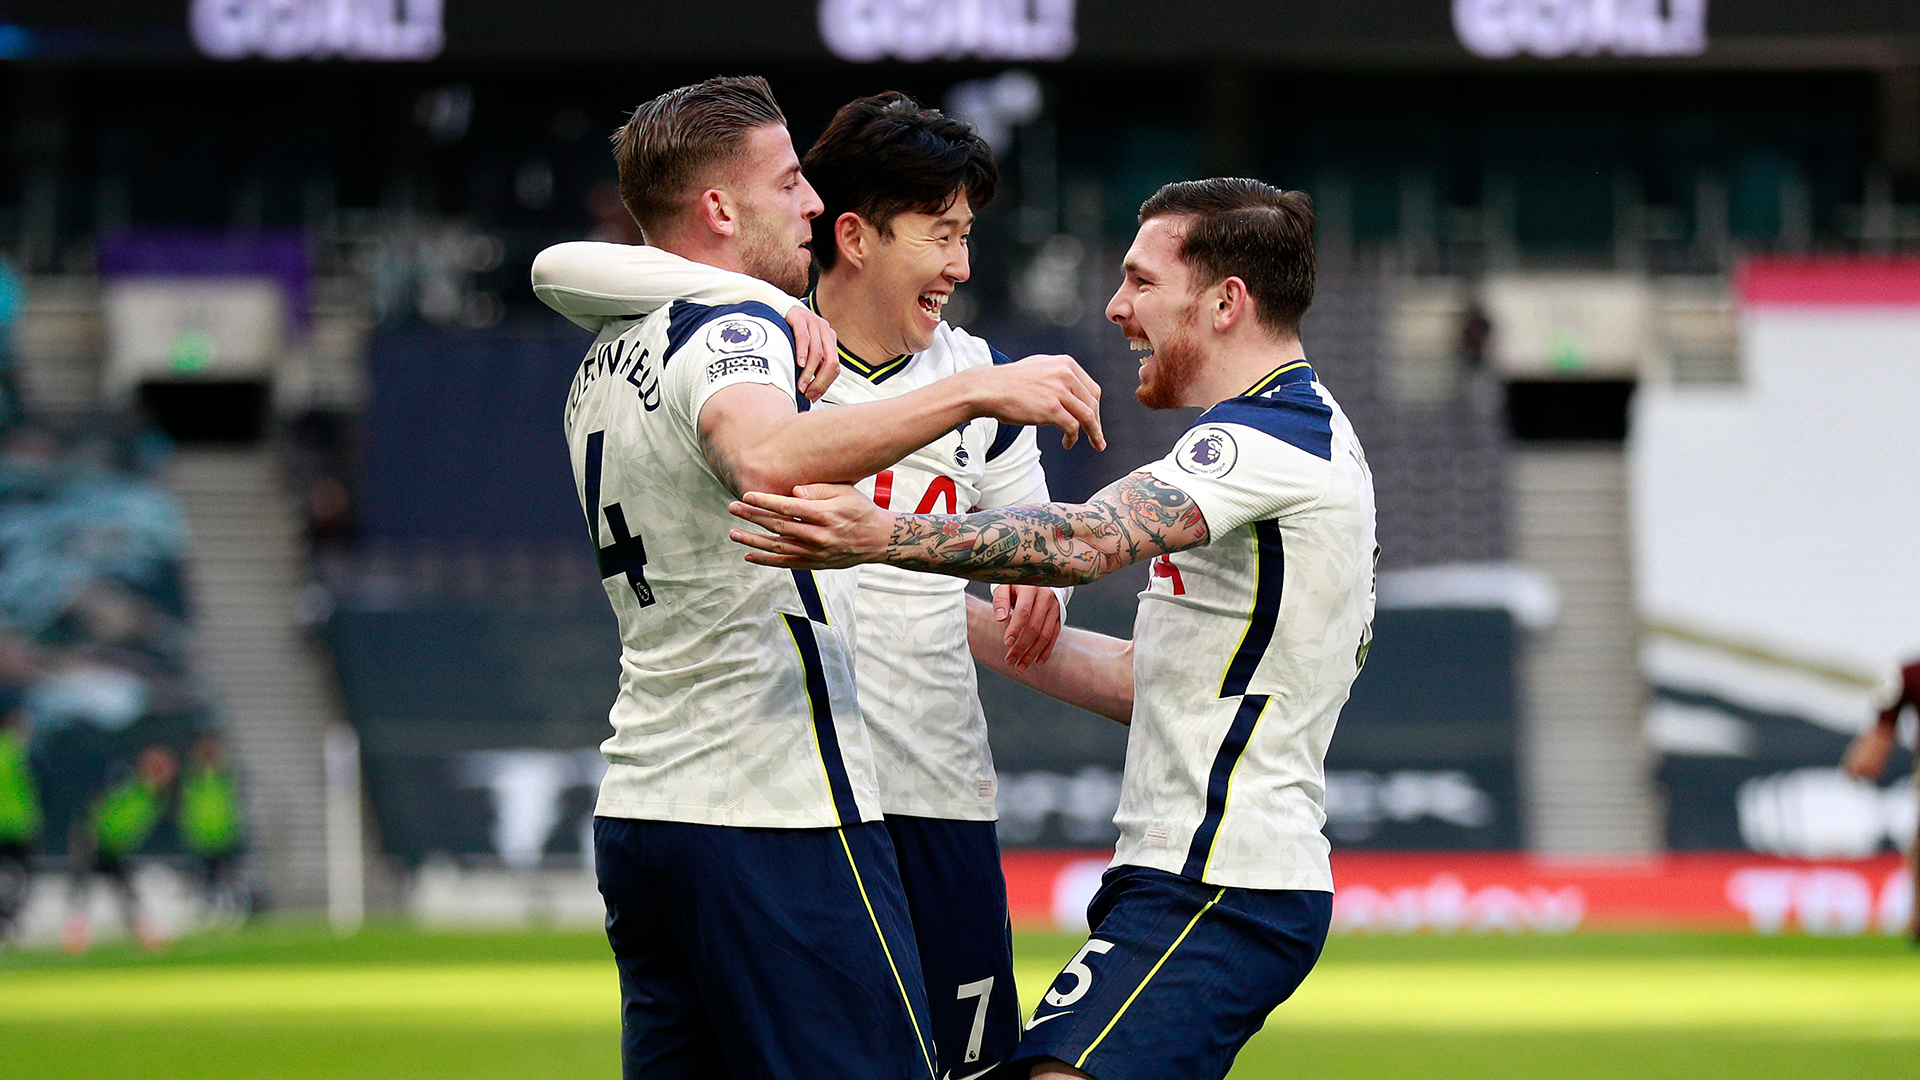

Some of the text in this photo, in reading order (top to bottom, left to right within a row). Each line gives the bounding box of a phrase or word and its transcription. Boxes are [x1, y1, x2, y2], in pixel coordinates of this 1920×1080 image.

[726, 357, 765, 368] room
[585, 430, 656, 609] 4
[1045, 939, 1116, 1007] 5
[957, 976, 994, 1063] 7
